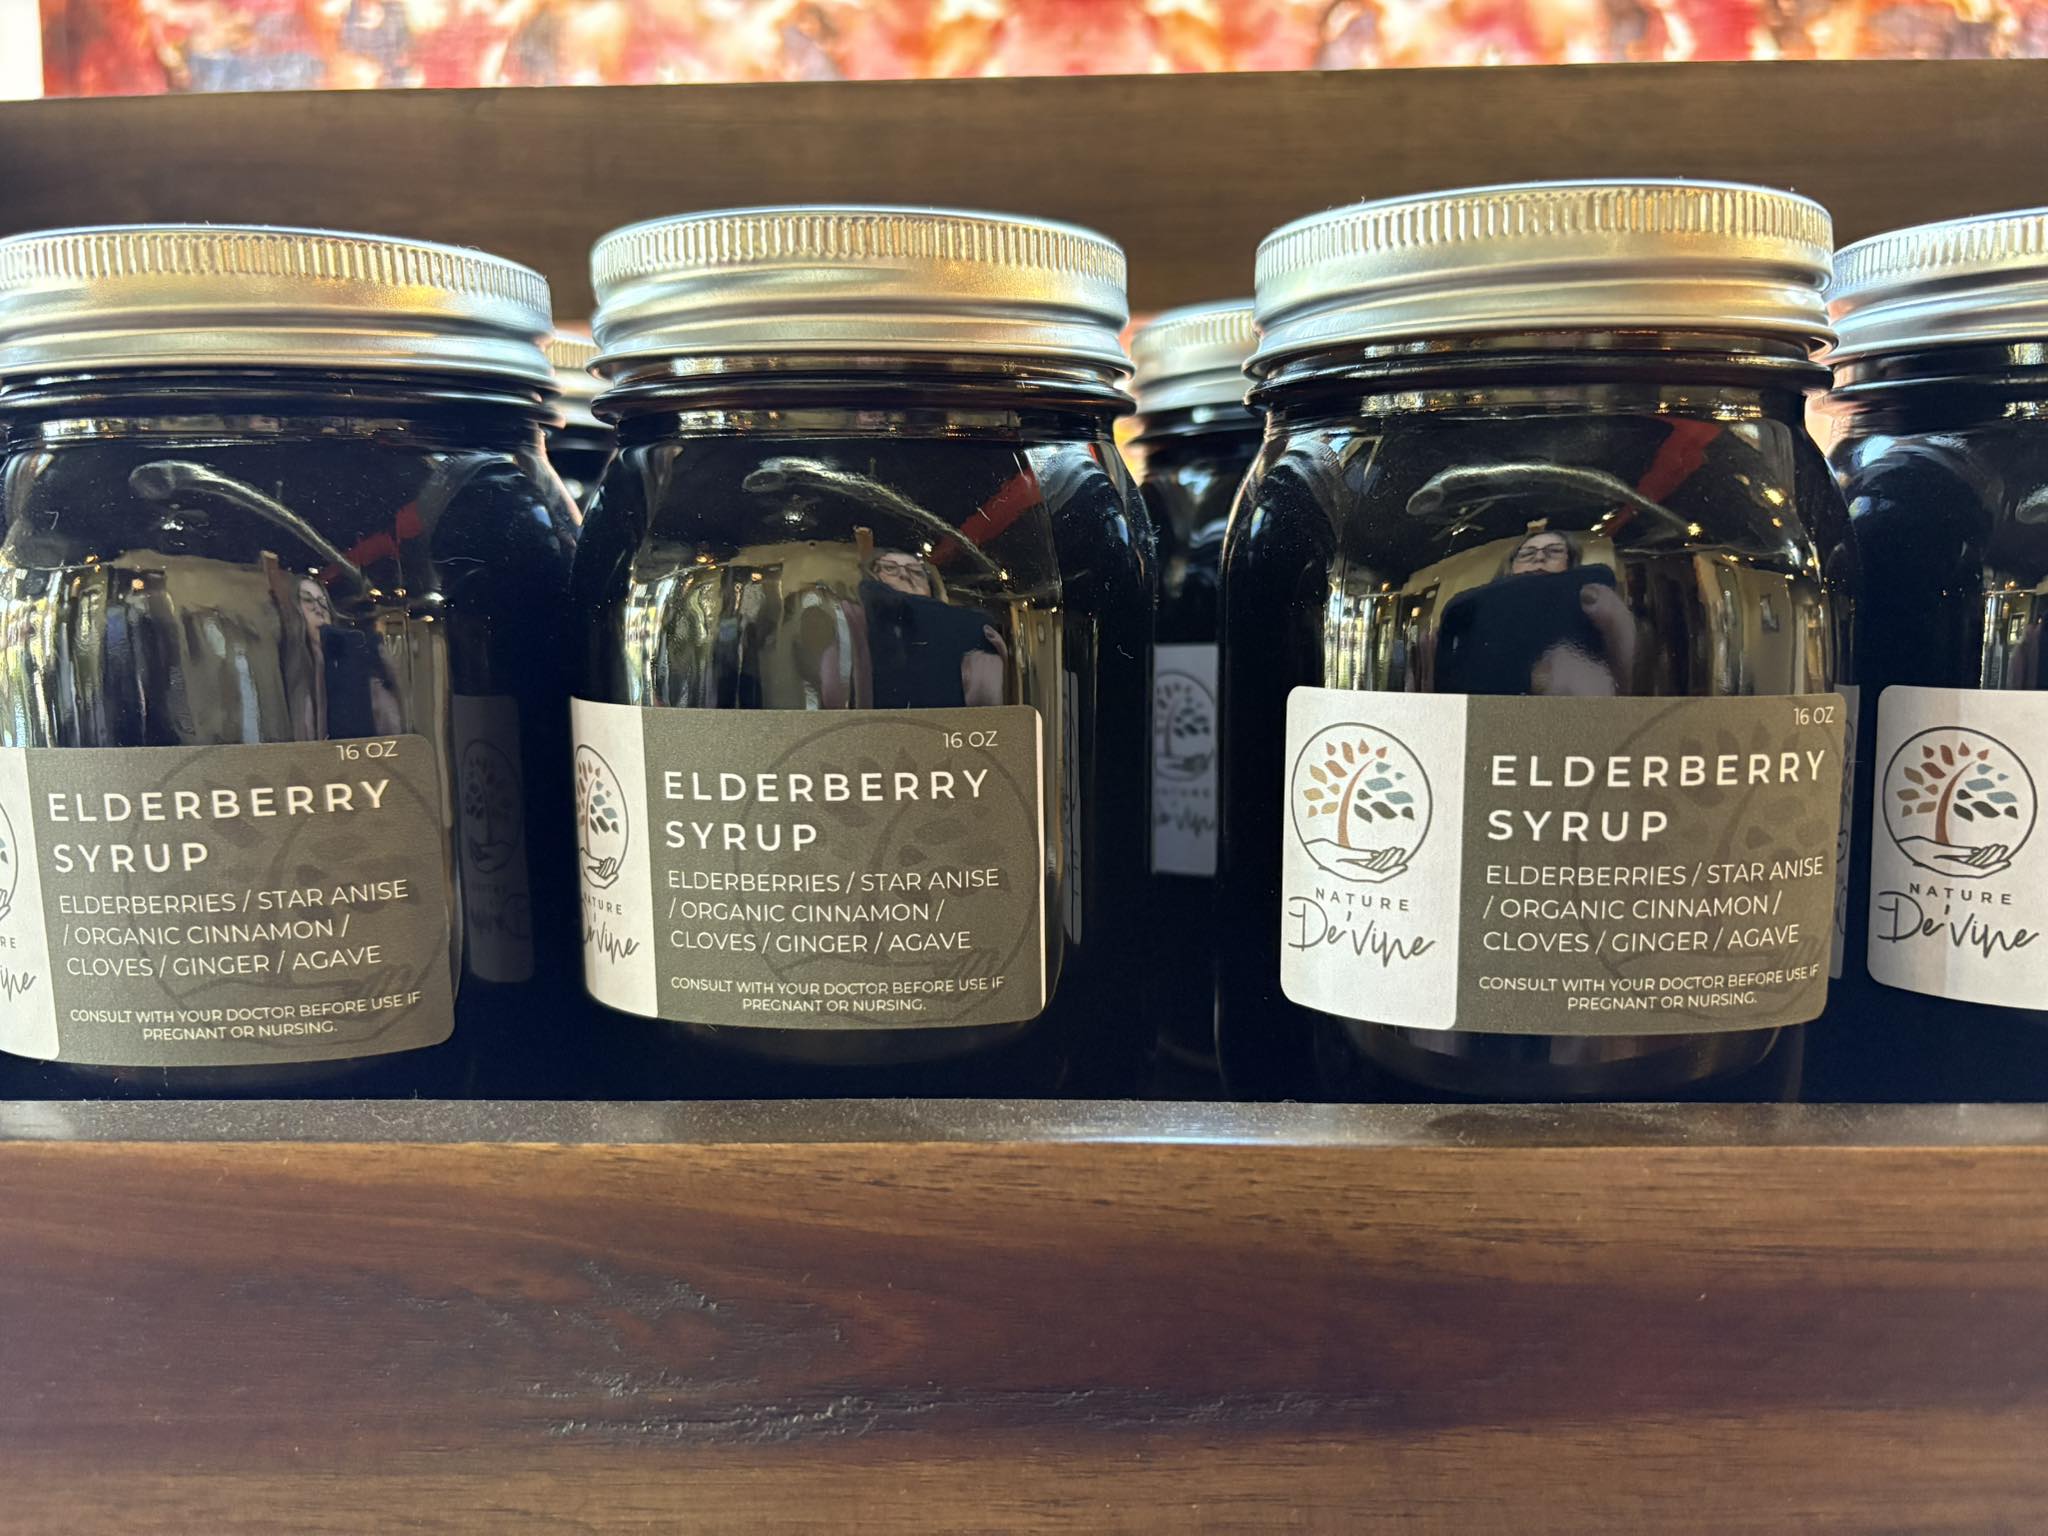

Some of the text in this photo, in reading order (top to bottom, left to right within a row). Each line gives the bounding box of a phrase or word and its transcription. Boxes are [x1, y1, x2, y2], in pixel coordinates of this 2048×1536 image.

[1794, 706, 1834, 725] 16 OZ
[336, 741, 398, 760] 16 OZ
[944, 731, 998, 748] 16 OZ
[1492, 750, 1824, 787] ELDERBERRY
[665, 769, 987, 801] ELDERBERRY
[49, 780, 388, 821] ELDERBERRY
[666, 821, 816, 851] SYRUP
[1488, 810, 1667, 841] SYRUP
[54, 843, 207, 873] SYRUP
[1487, 856, 1823, 887] ELDERBERRIES / STAR ANISE
[669, 869, 999, 894] ELDERBERRIES / STAR ANISE
[1909, 883, 2012, 906] NATURE
[60, 880, 408, 914] ELDERBERRIES / STAR ANISE
[669, 897, 944, 922] / ORGANIC CINNAMON /
[1315, 887, 1409, 912] NATURE
[1483, 890, 1782, 919] / ORGANIC CINNAMON /
[63, 914, 349, 946] / ORGANIC CINNAMON /
[671, 930, 970, 954] CLOVES / GINGER / AGAVE
[1484, 924, 1799, 954] CLOVES / GINGER / AGAVE
[67, 945, 381, 978] CLOVES / GINGER / AGAVE
[671, 976, 1004, 995] CONSULT WITH YOUR DOCTOR BEFORE USE IF
[1479, 964, 1819, 991] CONSULT WITH YOUR DOCTOR BEFORE USE IF
[70, 991, 420, 1023] CONSULT WITH YOUR DOCTOR BEFORE USE IF
[743, 999, 927, 1011] PREGNANT OR NURSING.
[1568, 992, 1757, 1010] PREGNANT OR NURSING.
[143, 1020, 338, 1040] PREGNANT OR NURSING.
